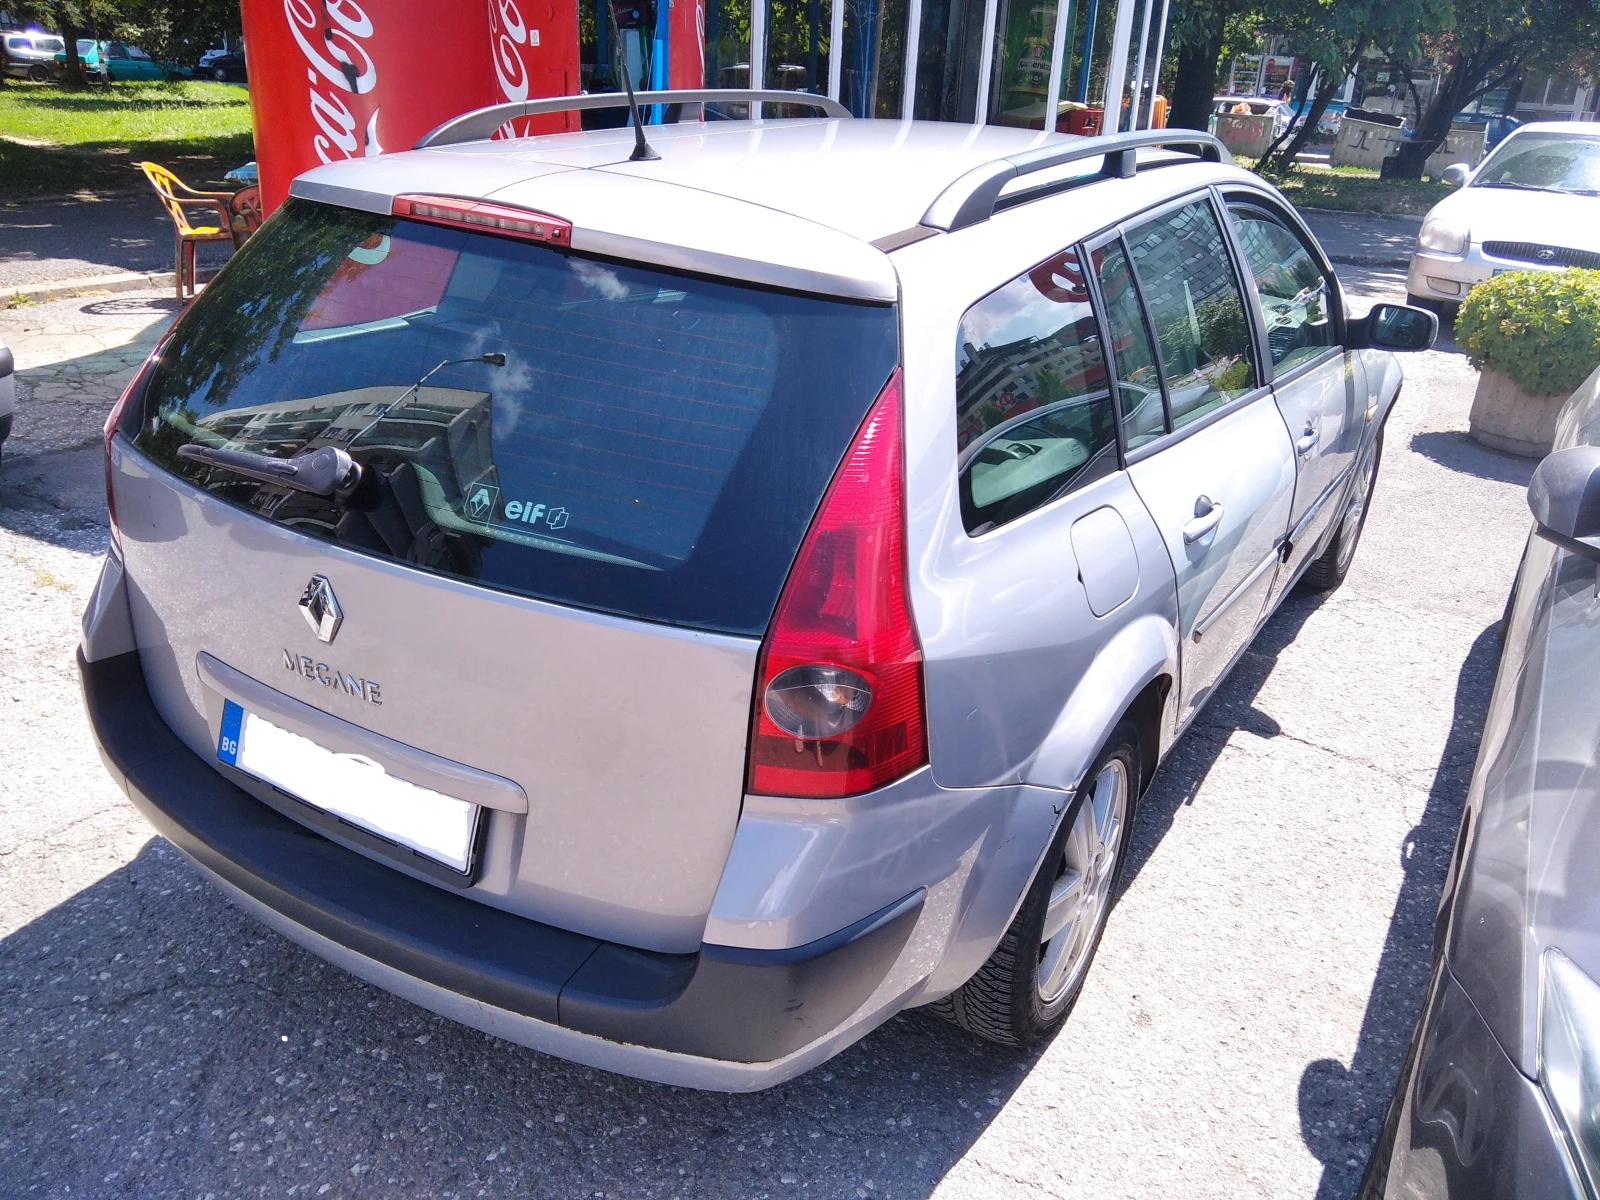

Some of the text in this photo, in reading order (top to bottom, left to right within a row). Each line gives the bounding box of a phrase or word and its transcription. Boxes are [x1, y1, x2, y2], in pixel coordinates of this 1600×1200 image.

[1018, 60, 1051, 71] Kamenitz
[504, 500, 546, 524] elf
[282, 648, 383, 706] MEGANE
[221, 736, 237, 755] BG
